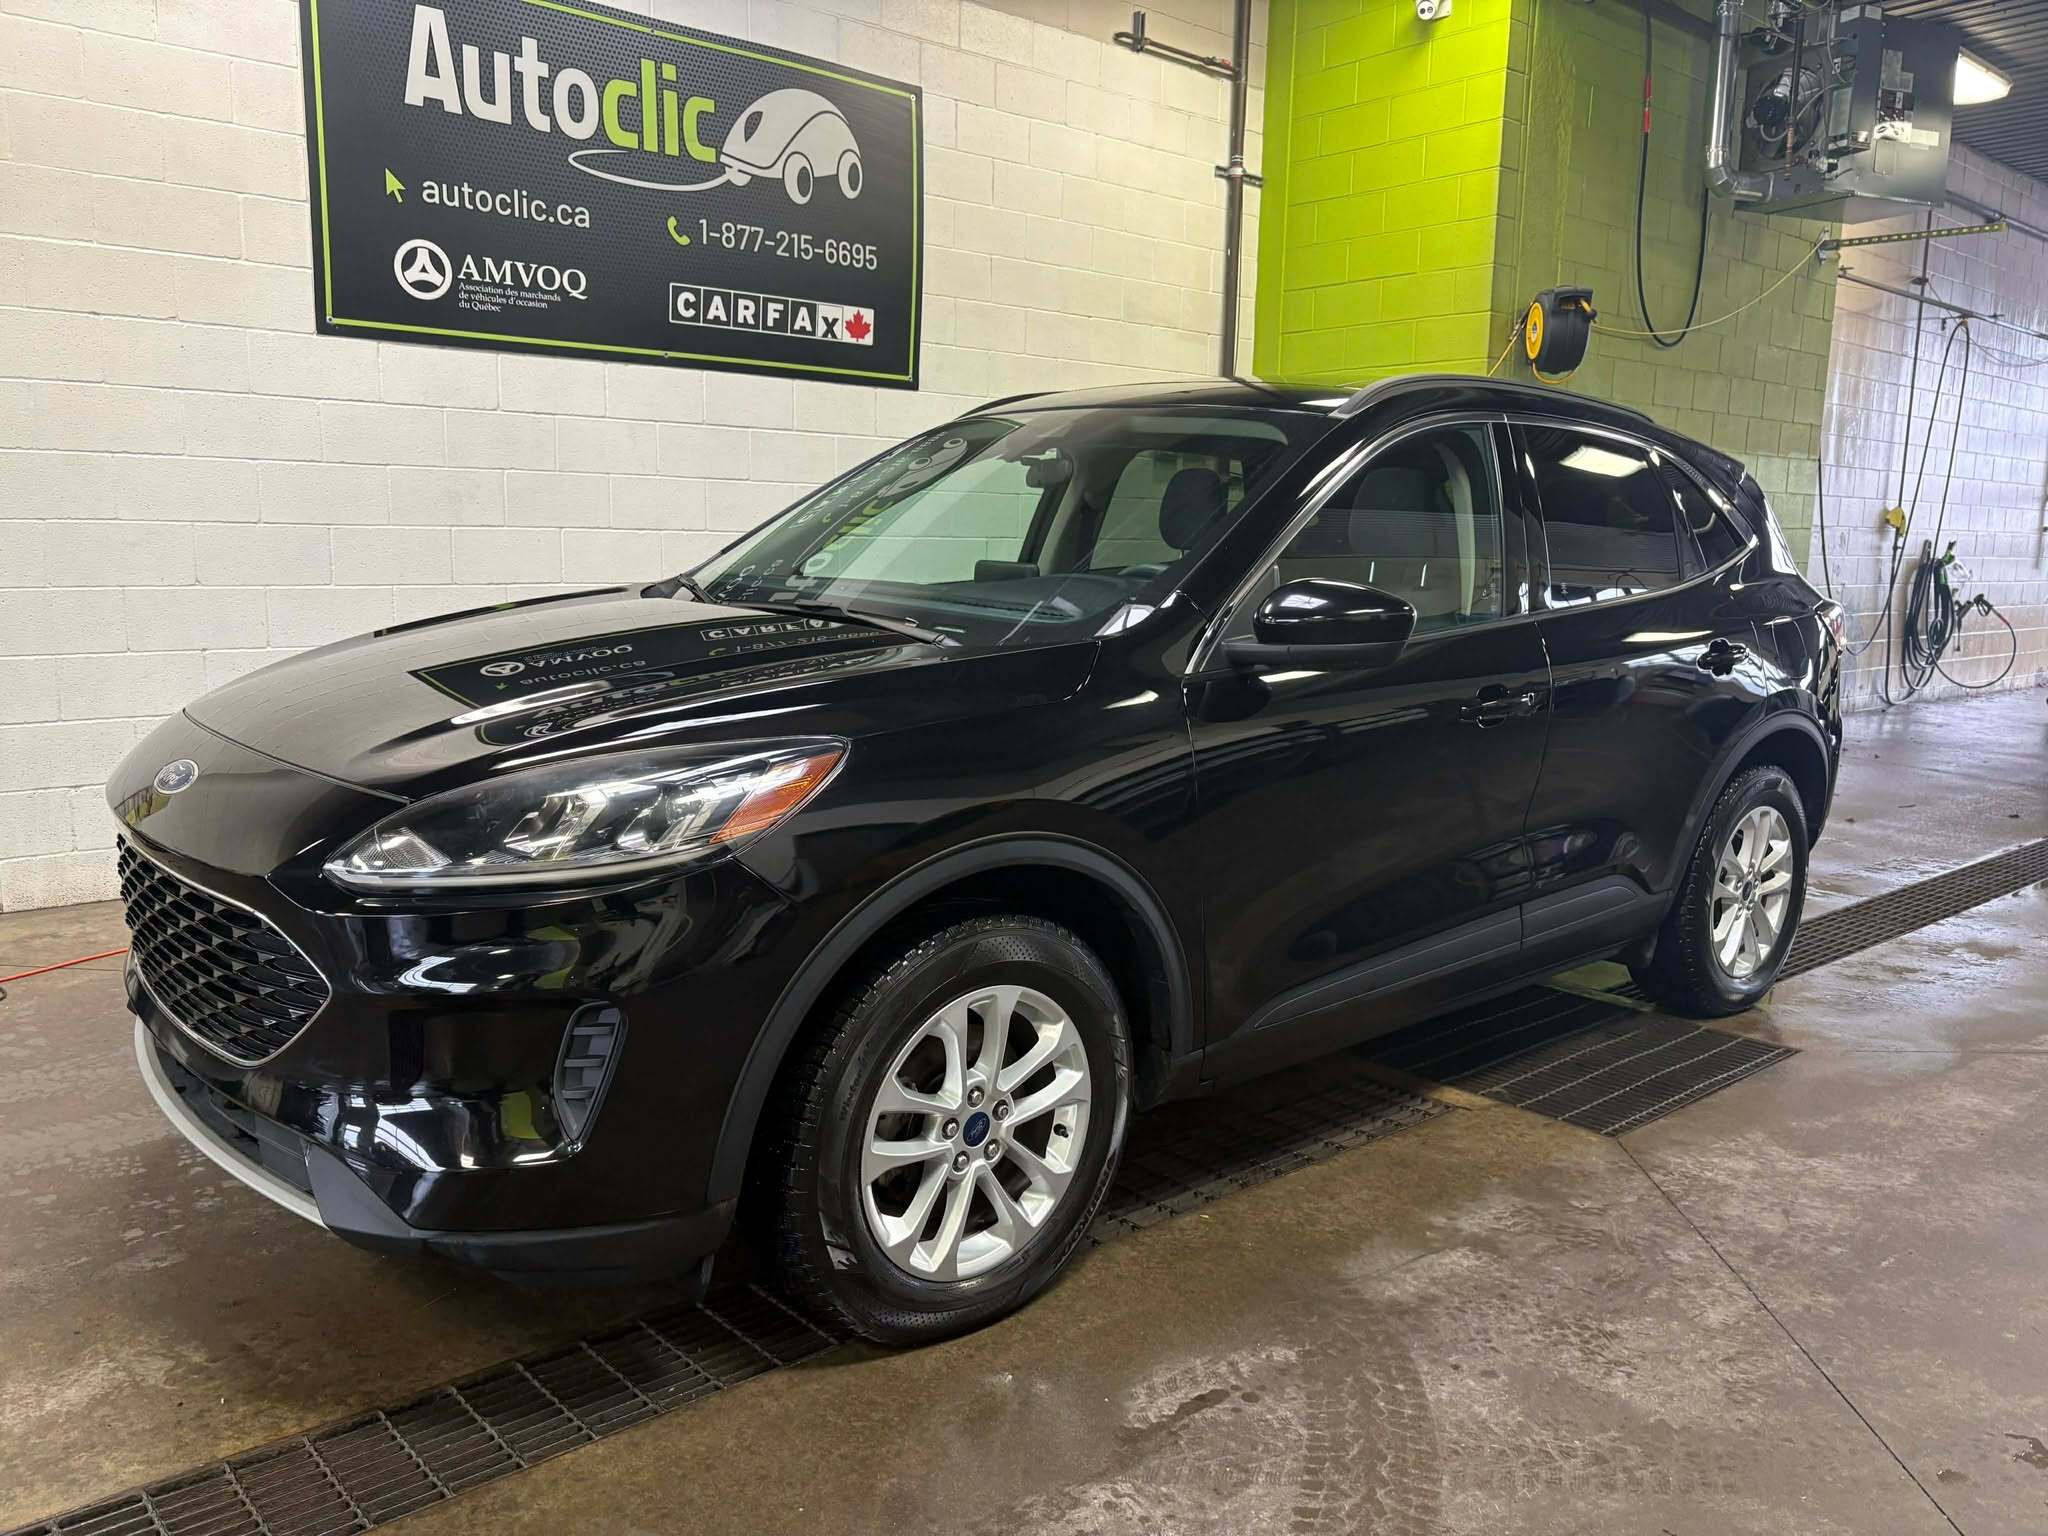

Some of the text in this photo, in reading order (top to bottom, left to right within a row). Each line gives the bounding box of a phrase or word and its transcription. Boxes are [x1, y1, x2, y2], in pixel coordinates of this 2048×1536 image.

[404, 3, 717, 163] Autoclic
[422, 180, 590, 228] autoclic.ca
[699, 218, 878, 271] 1-877-215-6695
[457, 254, 588, 300] AMVOQ
[459, 282, 561, 302] Association des marchands
[459, 291, 548, 309] de véhicules d'occasion
[459, 300, 501, 313] du Québec
[676, 291, 840, 340] CARFAX
